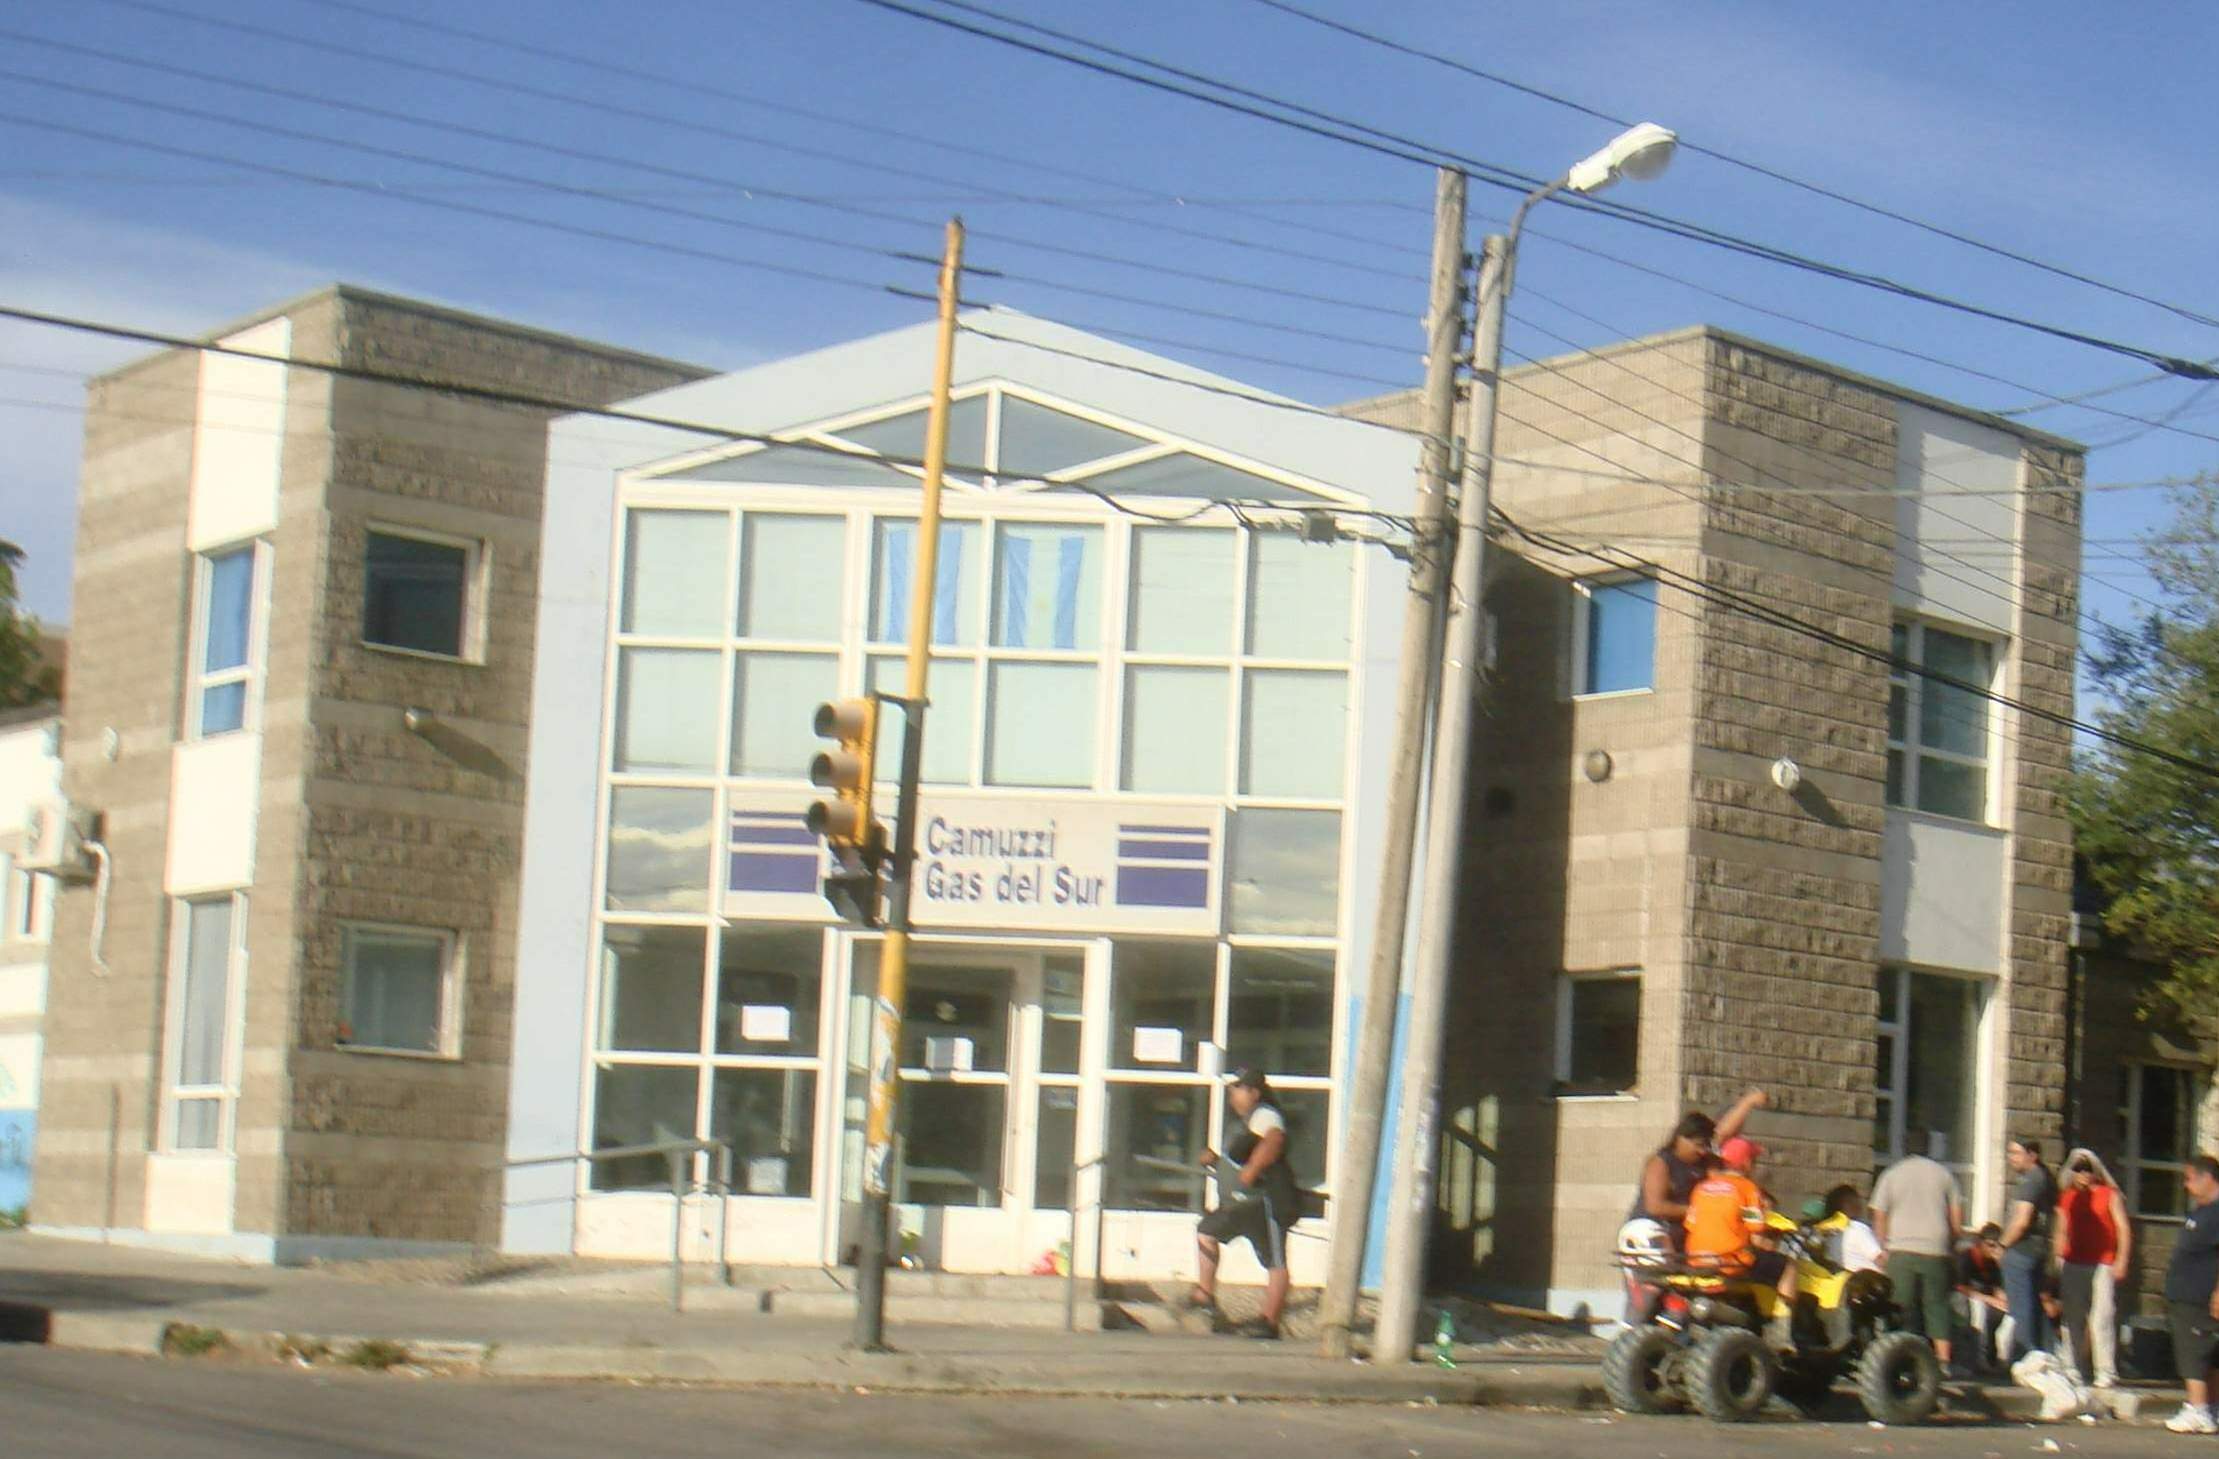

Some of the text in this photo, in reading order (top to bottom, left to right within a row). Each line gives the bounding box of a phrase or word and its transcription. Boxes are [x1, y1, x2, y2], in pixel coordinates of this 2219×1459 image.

[928, 816, 1056, 857] Camuzzi
[926, 861, 1104, 904] Gas del Sur
